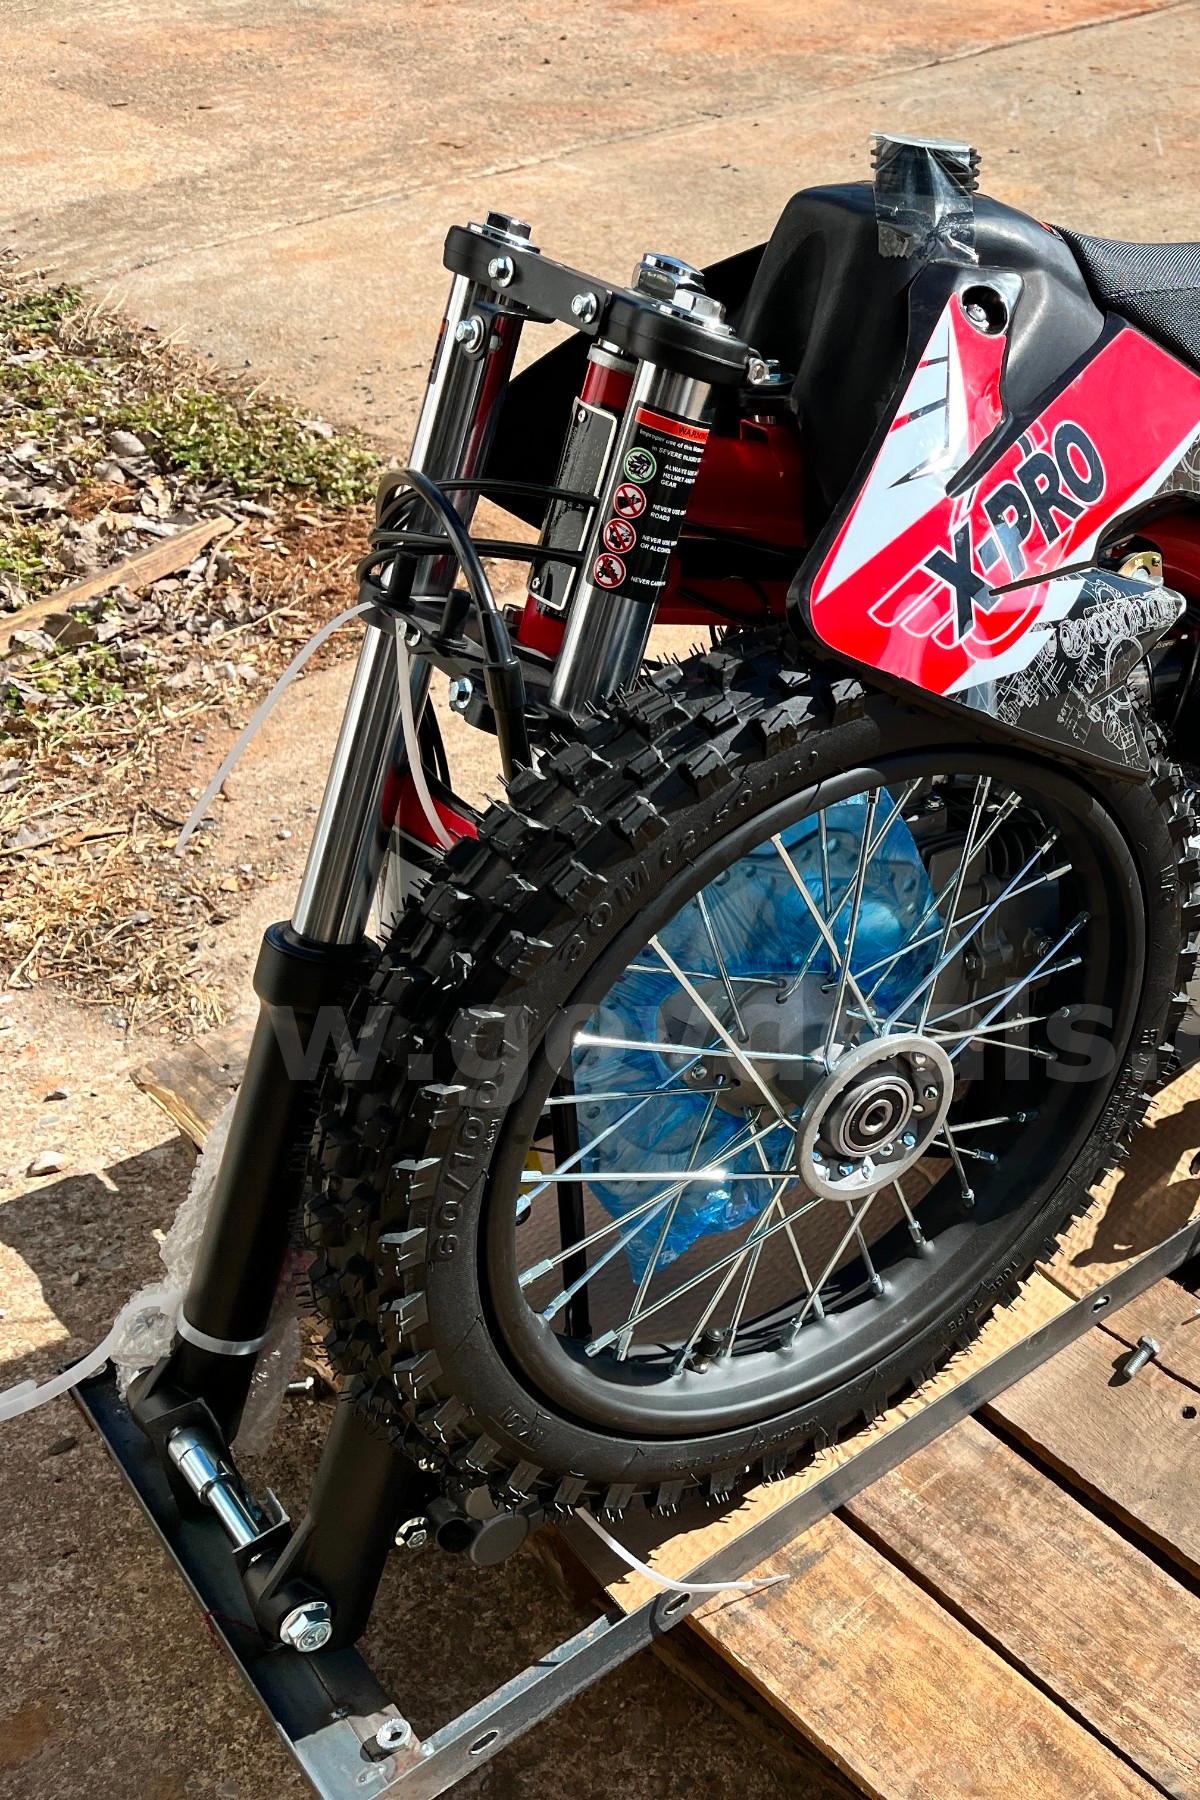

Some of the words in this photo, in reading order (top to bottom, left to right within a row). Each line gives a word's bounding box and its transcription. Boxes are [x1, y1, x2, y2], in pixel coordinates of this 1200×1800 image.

[659, 447, 682, 459] SEVERE
[662, 472, 685, 483] HELMET
[660, 479, 677, 488] GEAR
[652, 504, 672, 514] NEVER
[650, 511, 671, 522] ROADS
[923, 419, 1106, 645] X-PRO
[641, 534, 662, 545] NEVER
[640, 542, 649, 550] OR
[630, 575, 650, 585] NEVER
[948, 1300, 983, 1333] TYPE
